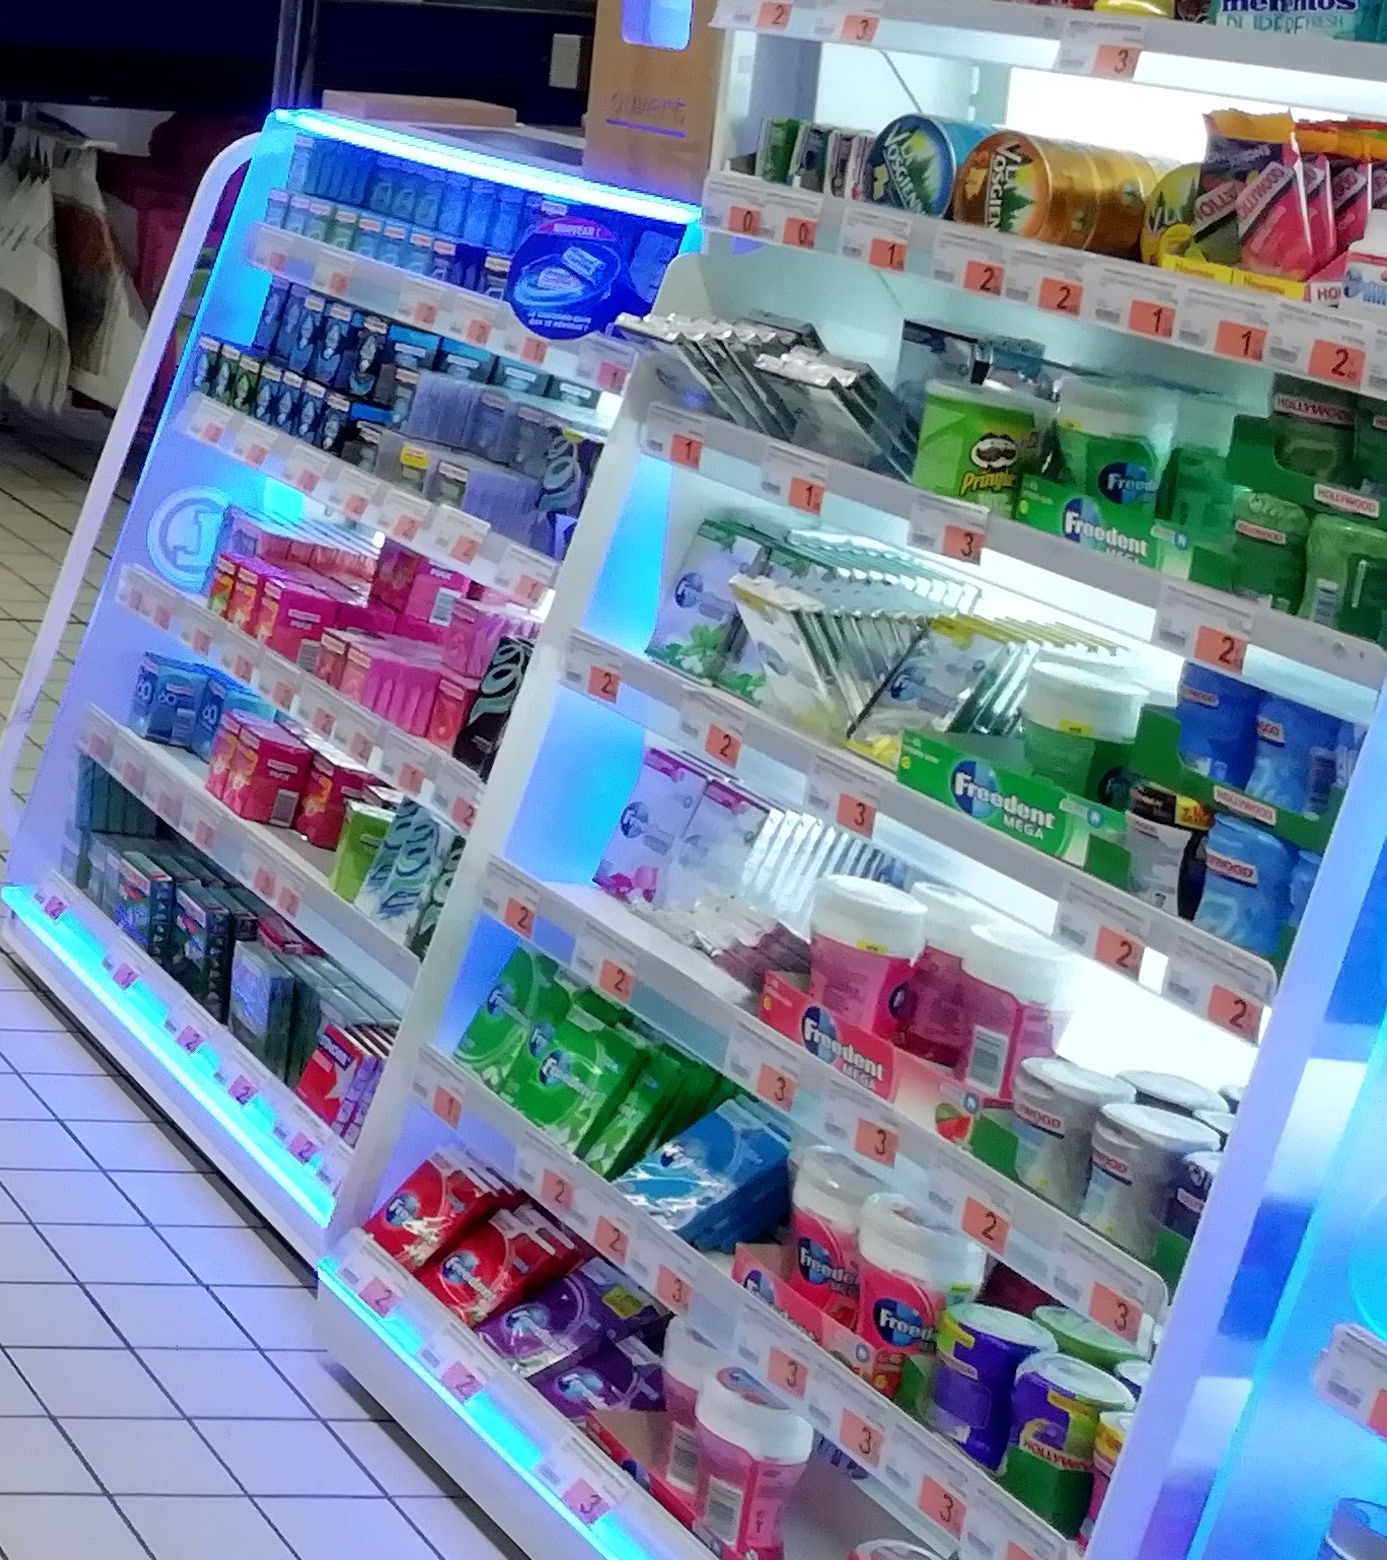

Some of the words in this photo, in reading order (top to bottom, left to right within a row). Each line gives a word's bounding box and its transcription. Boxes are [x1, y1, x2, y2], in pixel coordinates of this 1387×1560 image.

[1065, 511, 1150, 558] Freedent
[954, 771, 1056, 830] Freedent
[1003, 814, 1045, 840] MEGA
[805, 1018, 885, 1082] Freedent
